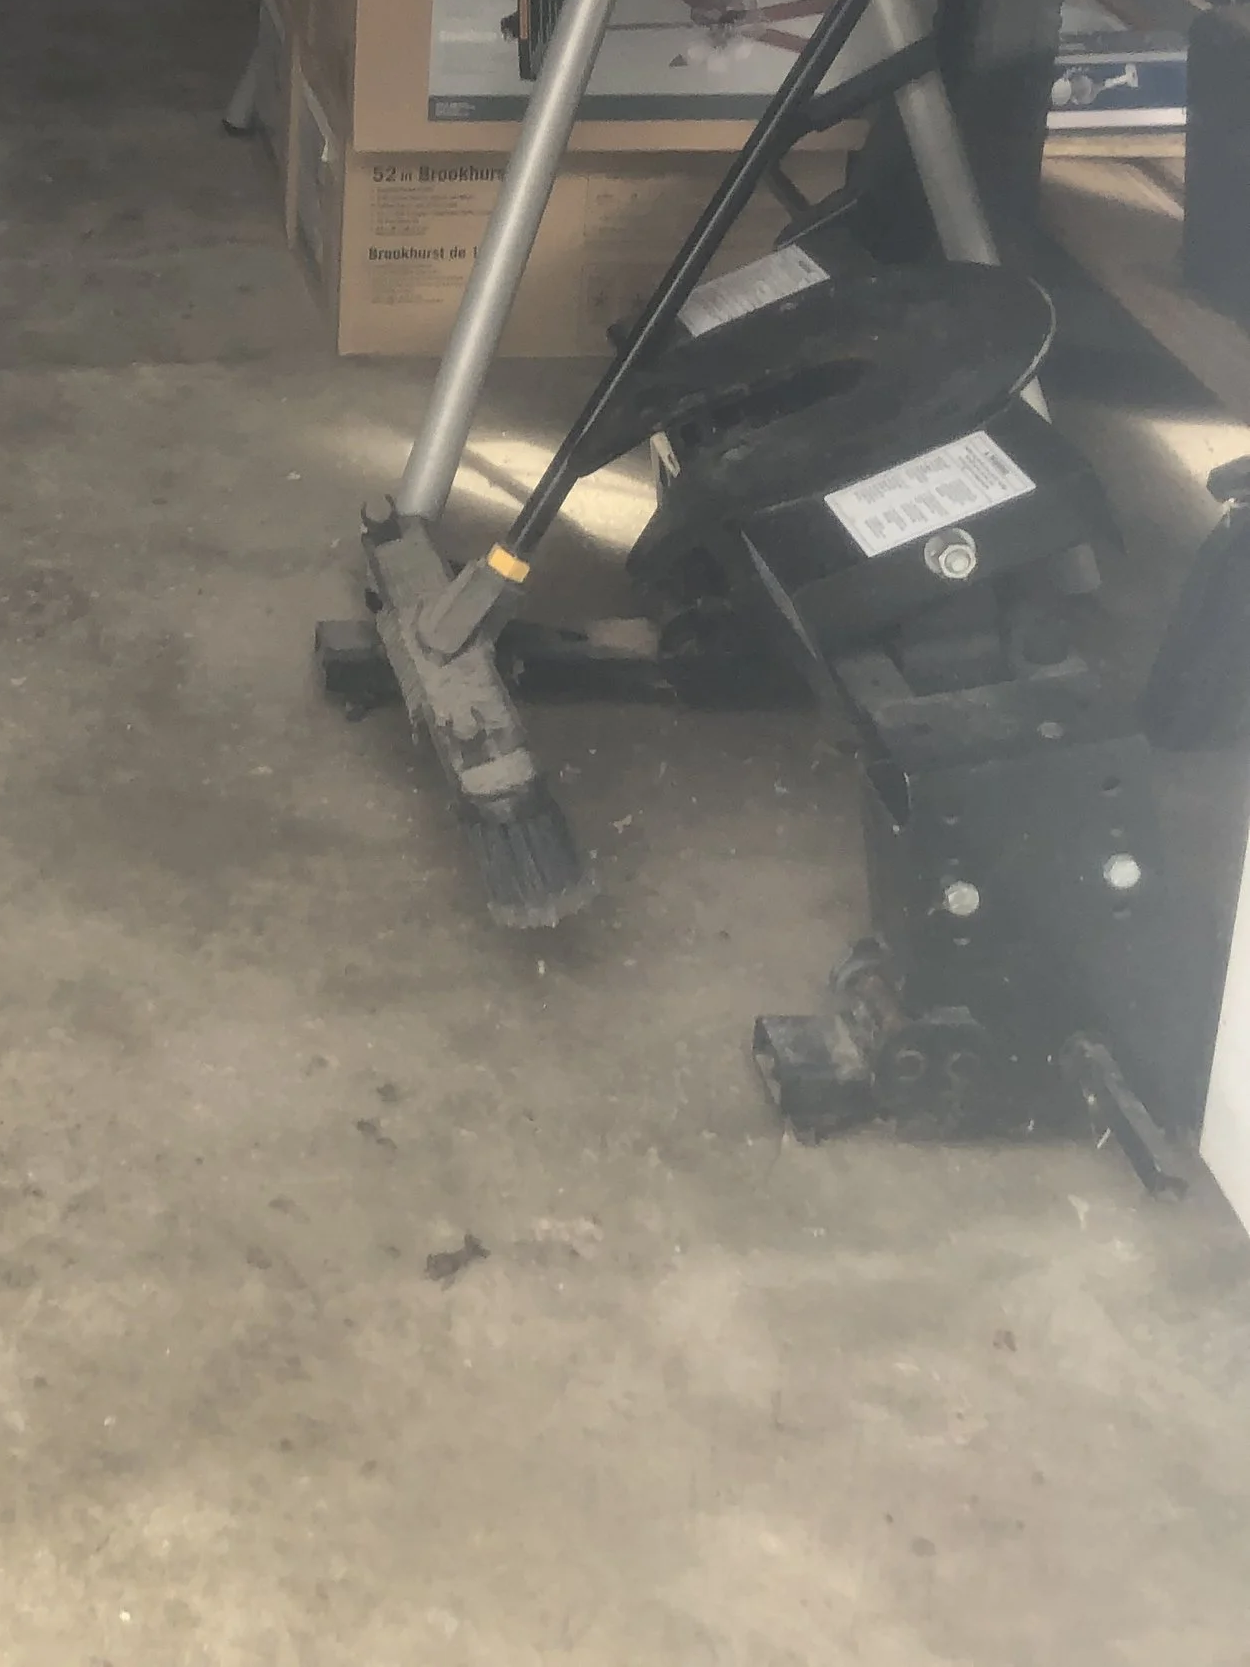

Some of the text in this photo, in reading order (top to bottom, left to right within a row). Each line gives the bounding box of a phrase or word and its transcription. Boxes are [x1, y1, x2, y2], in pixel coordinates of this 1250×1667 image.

[373, 166, 396, 183] 52
[401, 171, 412, 183] in
[368, 246, 445, 261] Brookhurst
[450, 246, 466, 261] de
